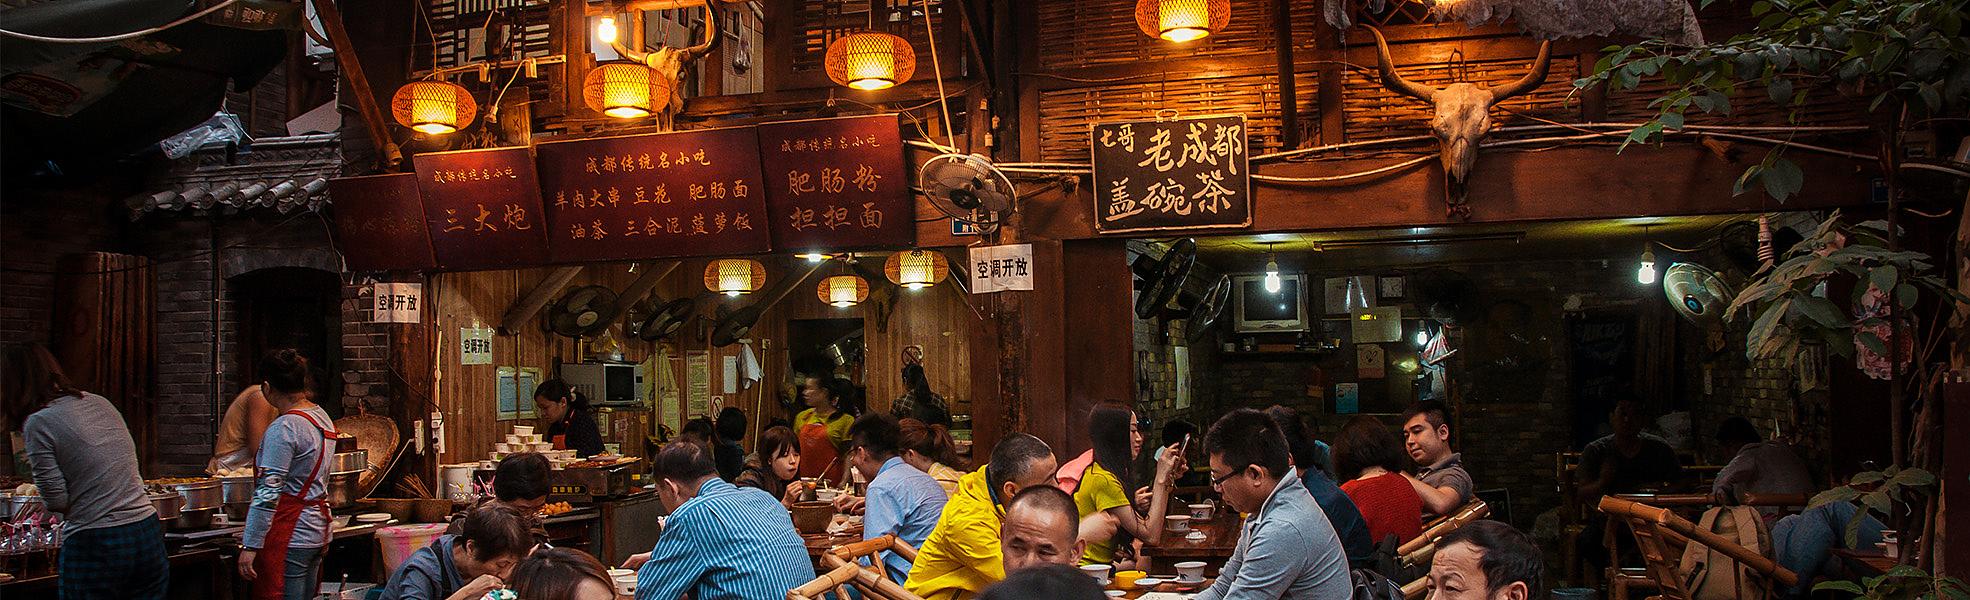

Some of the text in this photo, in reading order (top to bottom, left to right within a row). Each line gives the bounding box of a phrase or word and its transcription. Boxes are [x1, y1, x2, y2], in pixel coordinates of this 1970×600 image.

[585, 148, 711, 175] 成都传统名小吃
[1100, 122, 1242, 175] 七哥 老成都
[554, 179, 748, 210] 羊肉大串 豆花 肥肠面
[787, 163, 882, 196] 肥肠粉
[1105, 169, 1236, 222] 盖碗茶
[443, 203, 531, 233] 三大炮
[570, 218, 608, 241] 油茶
[624, 216, 683, 237] 三合泥
[790, 202, 883, 232] 担担面
[977, 257, 1028, 279] 空调开放
[378, 294, 418, 311] 空调开放
[463, 338, 490, 354] 空调开放
